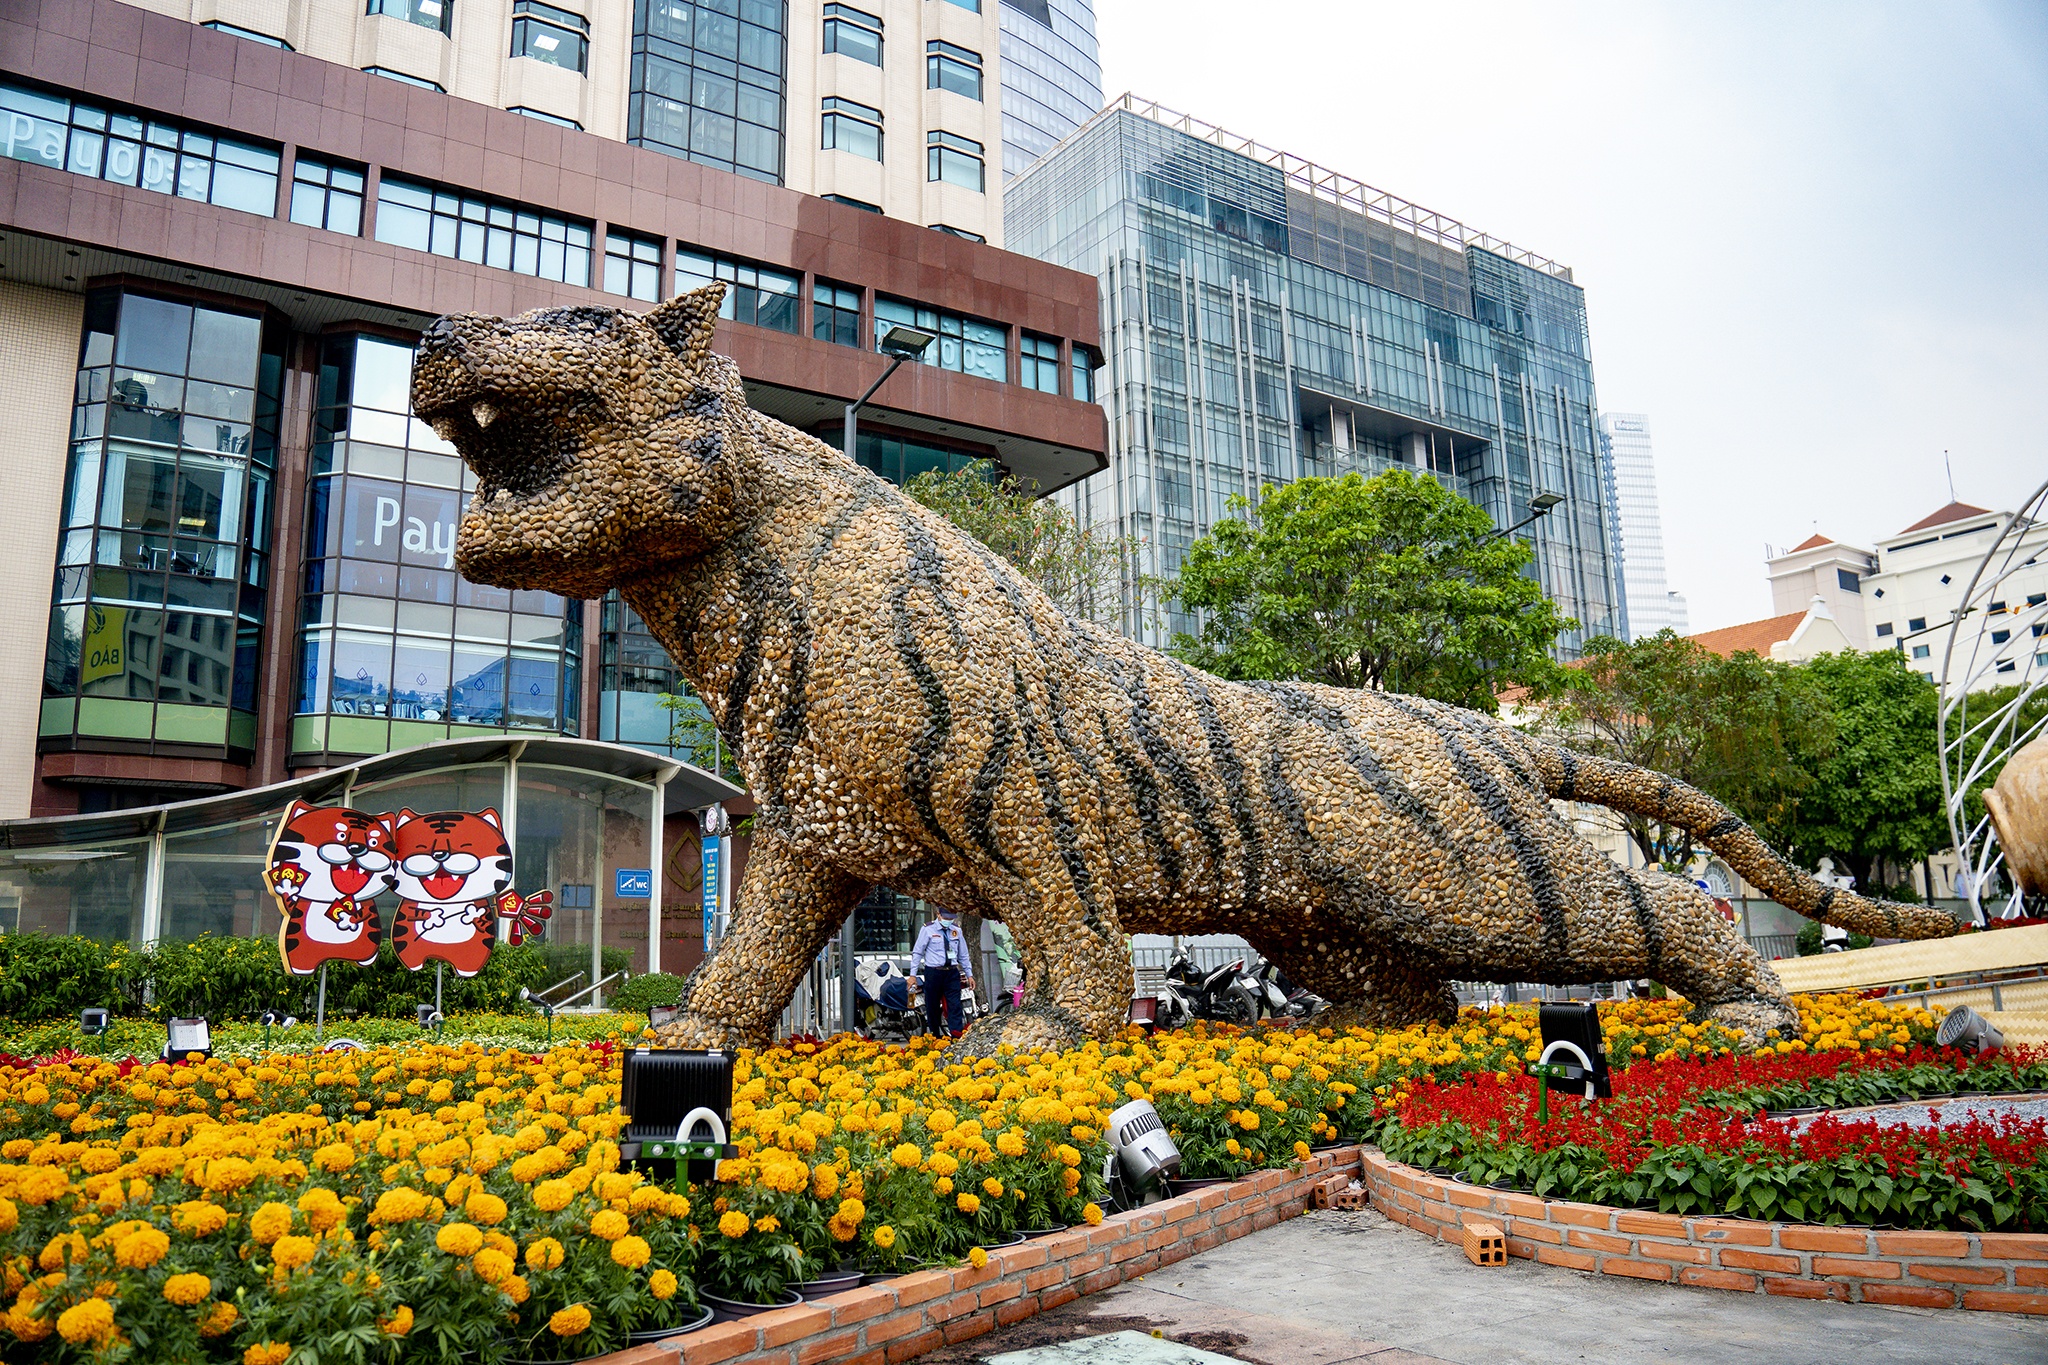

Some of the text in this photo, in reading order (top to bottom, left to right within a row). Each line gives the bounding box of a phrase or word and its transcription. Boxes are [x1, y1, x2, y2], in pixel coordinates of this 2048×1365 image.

[8, 112, 164, 184] Payoo
[374, 496, 456, 569] Pay
[636, 881, 648, 889] WC
[672, 902, 703, 912] Bangk
